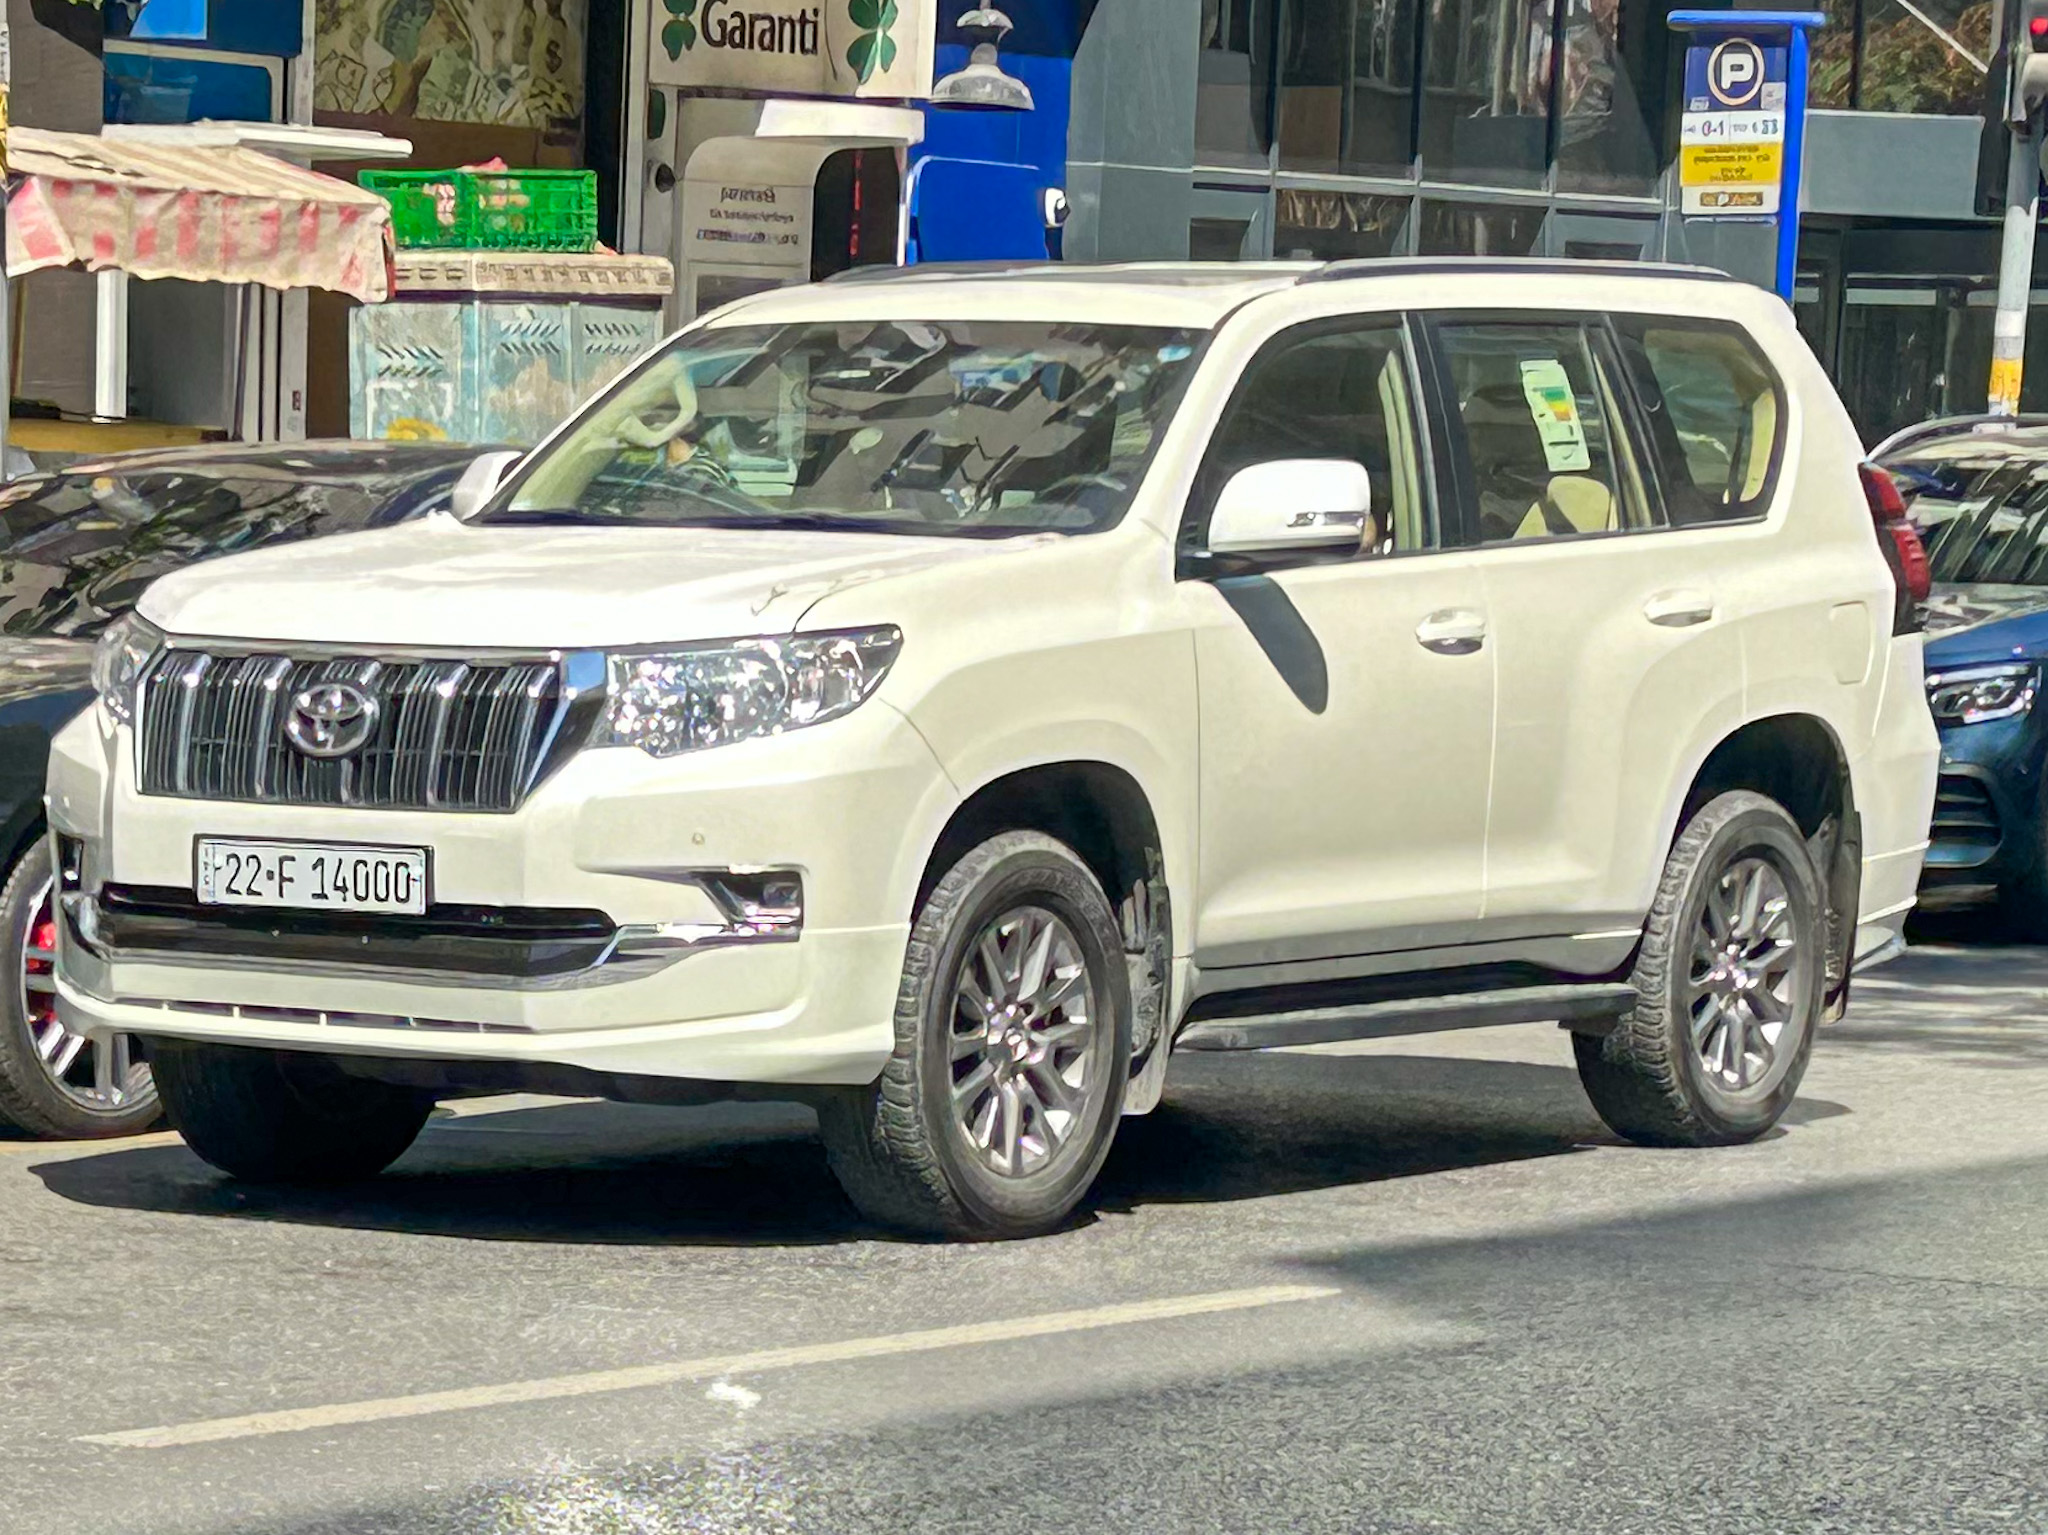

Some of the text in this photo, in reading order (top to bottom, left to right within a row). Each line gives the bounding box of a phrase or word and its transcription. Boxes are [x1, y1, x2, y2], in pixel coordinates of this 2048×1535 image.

[701, 0, 819, 56] Garanti
[1721, 53, 1754, 90] P
[311, 857, 412, 903] 14000
